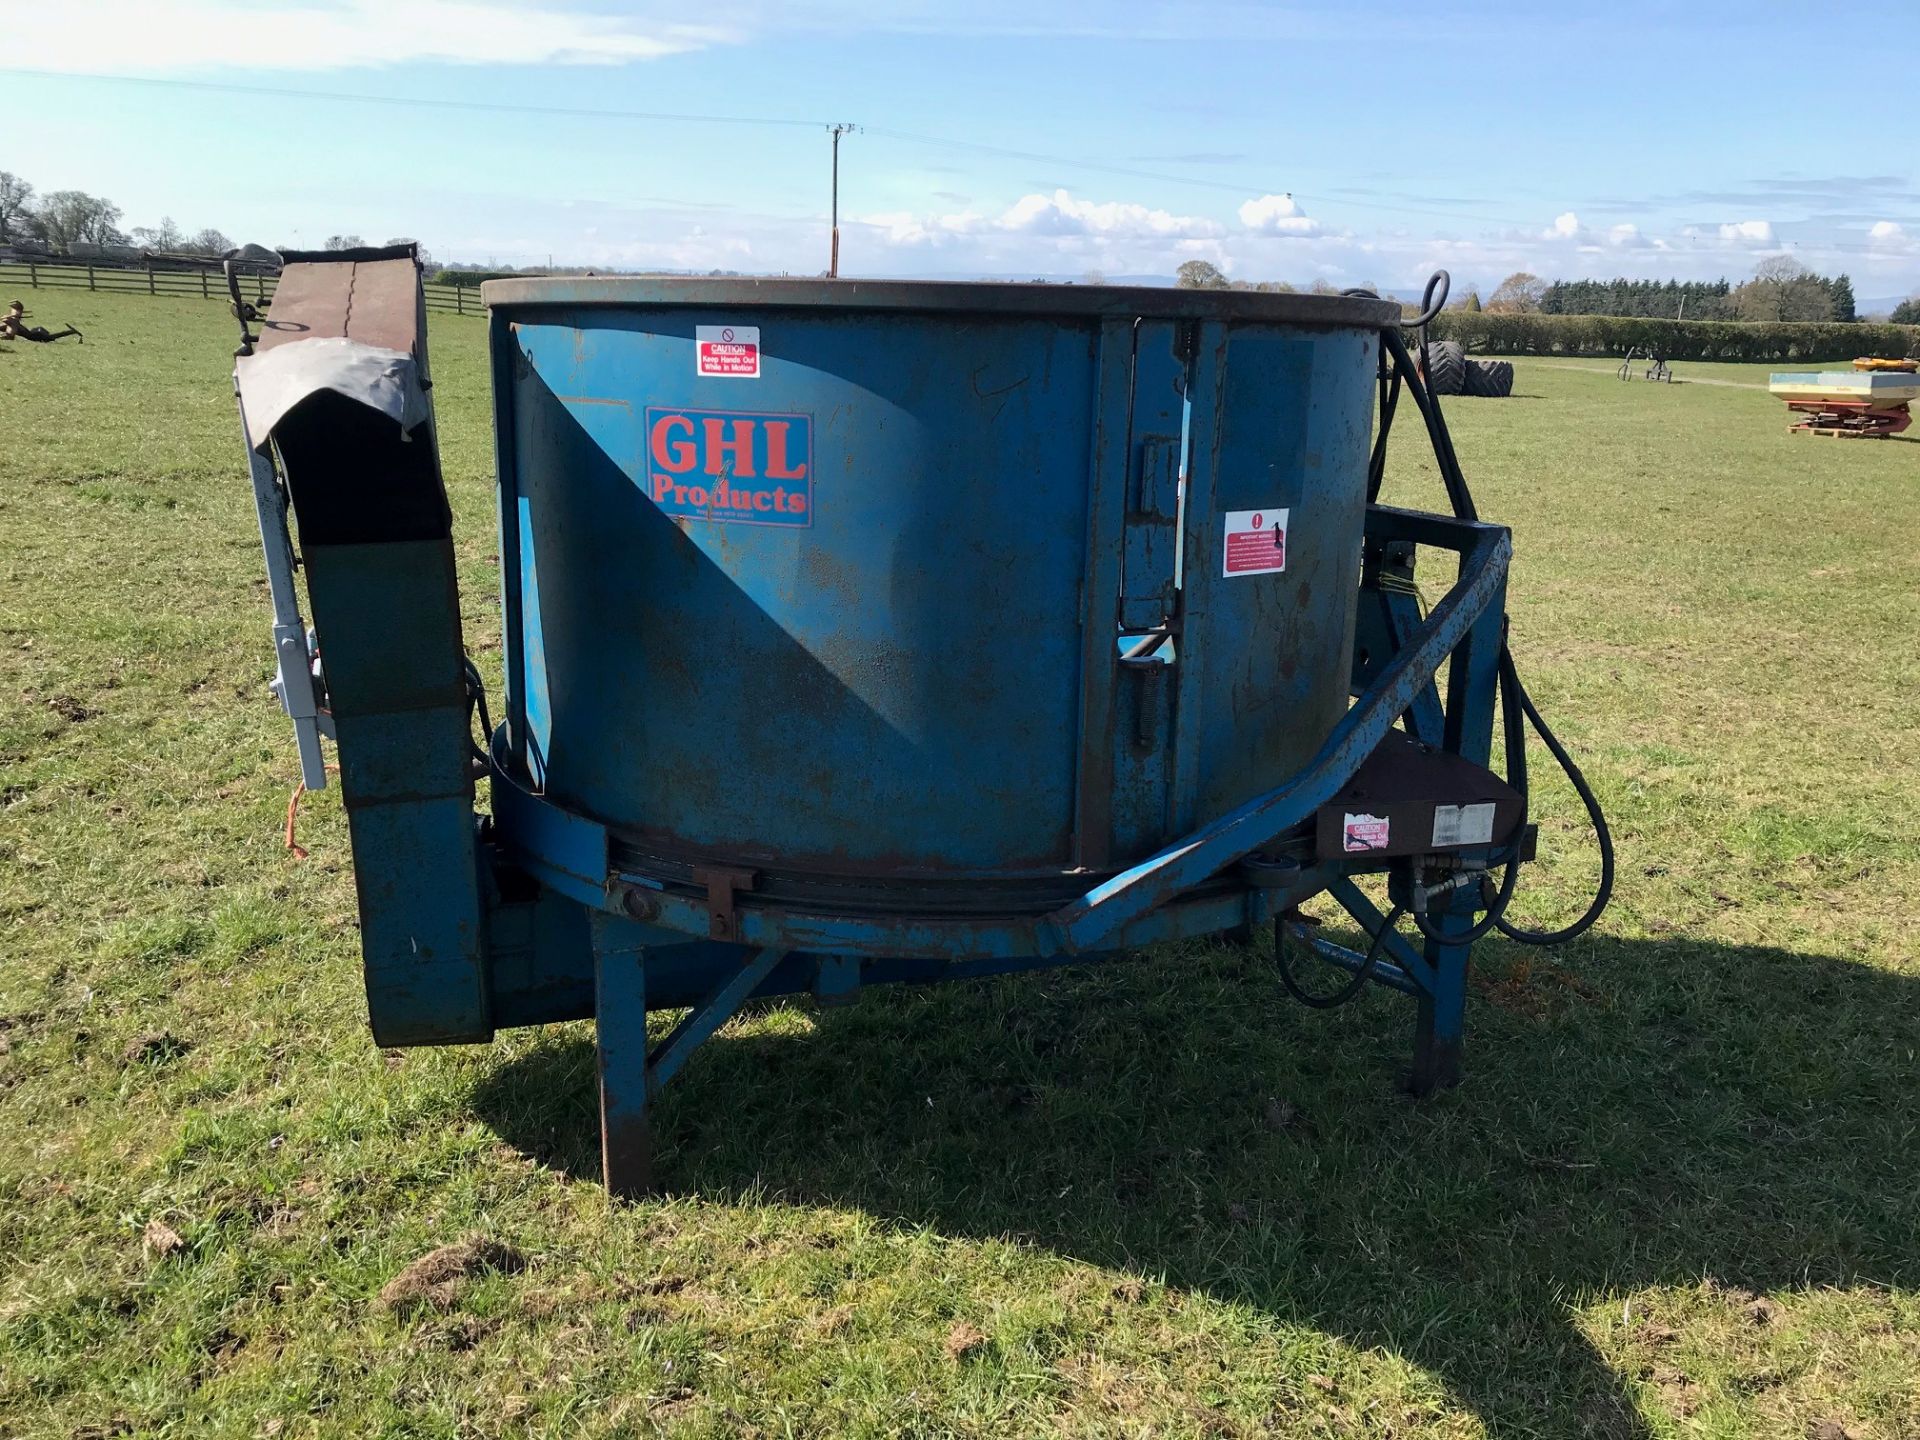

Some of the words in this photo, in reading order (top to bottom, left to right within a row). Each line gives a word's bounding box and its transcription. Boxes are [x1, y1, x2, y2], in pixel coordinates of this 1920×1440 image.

[711, 345, 745, 353] CAUTION
[703, 355, 719, 363] Keep
[721, 356, 741, 364] Hands
[742, 356, 755, 364] Out
[731, 364, 754, 372] Motion
[652, 415, 807, 480] GHL
[652, 474, 806, 513] Products
[1354, 824, 1380, 832] CAUTION
